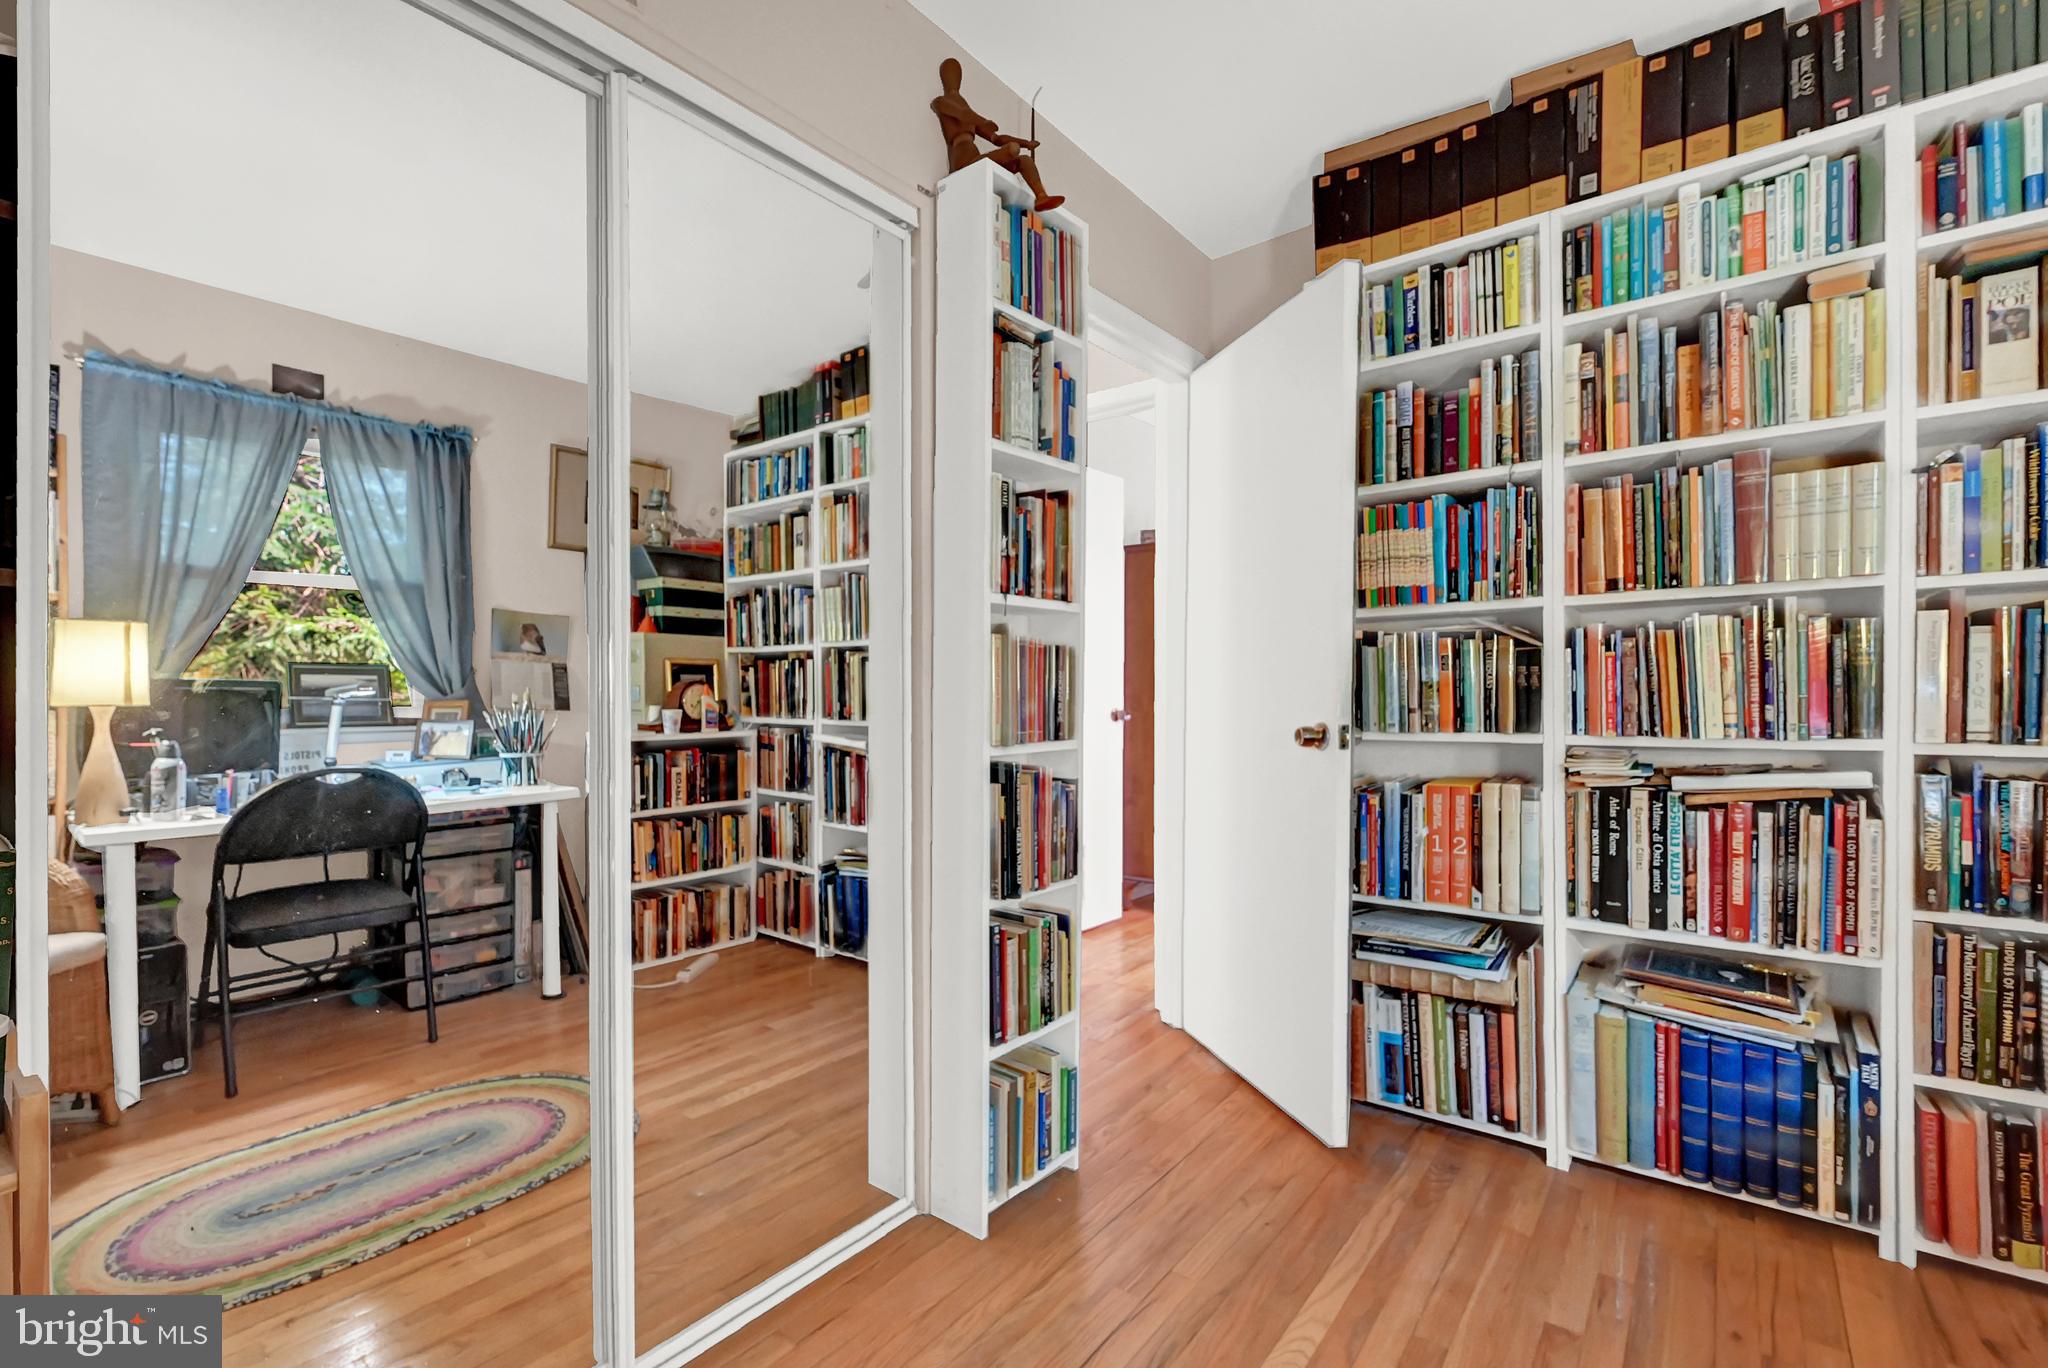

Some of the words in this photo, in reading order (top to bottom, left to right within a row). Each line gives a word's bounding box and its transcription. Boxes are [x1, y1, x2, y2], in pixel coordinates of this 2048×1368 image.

[1872, 15, 1886, 59] Photoshop
[1832, 30, 1846, 72] Photoshop
[1407, 289, 1416, 328] Warblers
[2028, 448, 2041, 504] Wildflowers
[2029, 505, 2040, 516] in
[2000, 784, 2010, 800] THE
[1609, 796, 1621, 817] Atlas
[1652, 801, 1664, 831] Atlante
[2000, 800, 2010, 833] APPIAN
[1610, 820, 1621, 832] of
[1652, 833, 1664, 841] di
[1847, 824, 1857, 837] THE
[1431, 834, 1443, 852] 1
[1452, 836, 1468, 855] 2
[1590, 828, 1600, 855] ROMAN
[1609, 832, 1620, 857] Rome
[1847, 840, 1857, 857] LOST
[1923, 821, 1942, 872] PYRAMIDS
[2000, 833, 2011, 852] WAY
[1652, 844, 1664, 866] Ostia
[1653, 868, 1663, 893] antica
[1846, 860, 1856, 887] WORLD
[1670, 884, 1681, 895] LE
[1846, 888, 1856, 898] OF
[1713, 885, 1725, 922] ROMANS
[1845, 901, 1856, 931] POMPEII
[1963, 935, 1977, 951] The
[2003, 941, 2016, 977] RIDDLES
[1961, 951, 1977, 1001] Rediscovery
[2003, 978, 2015, 990] OF
[1963, 1001, 1976, 1011] of
[2003, 991, 2015, 1008] THE
[1963, 1010, 1976, 1043] Ancient
[2002, 1009, 2014, 1043] SPHINX
[1459, 1029, 1469, 1070] Fishbourne
[1656, 1033, 1665, 1053] JOHN
[1960, 1042, 1976, 1067] Egypt
[1656, 1053, 1665, 1074] JAMES
[1861, 1064, 1870, 1085] ITALY
[1869, 1062, 1879, 1090] ANCIENT
[1657, 1075, 1665, 1108] AUDUBON
[1994, 1131, 2004, 1167] EGYPTIAN
[2019, 1152, 2032, 1169] The
[2019, 1172, 2034, 1199] Great
[2017, 1201, 2036, 1242] Pyramid
